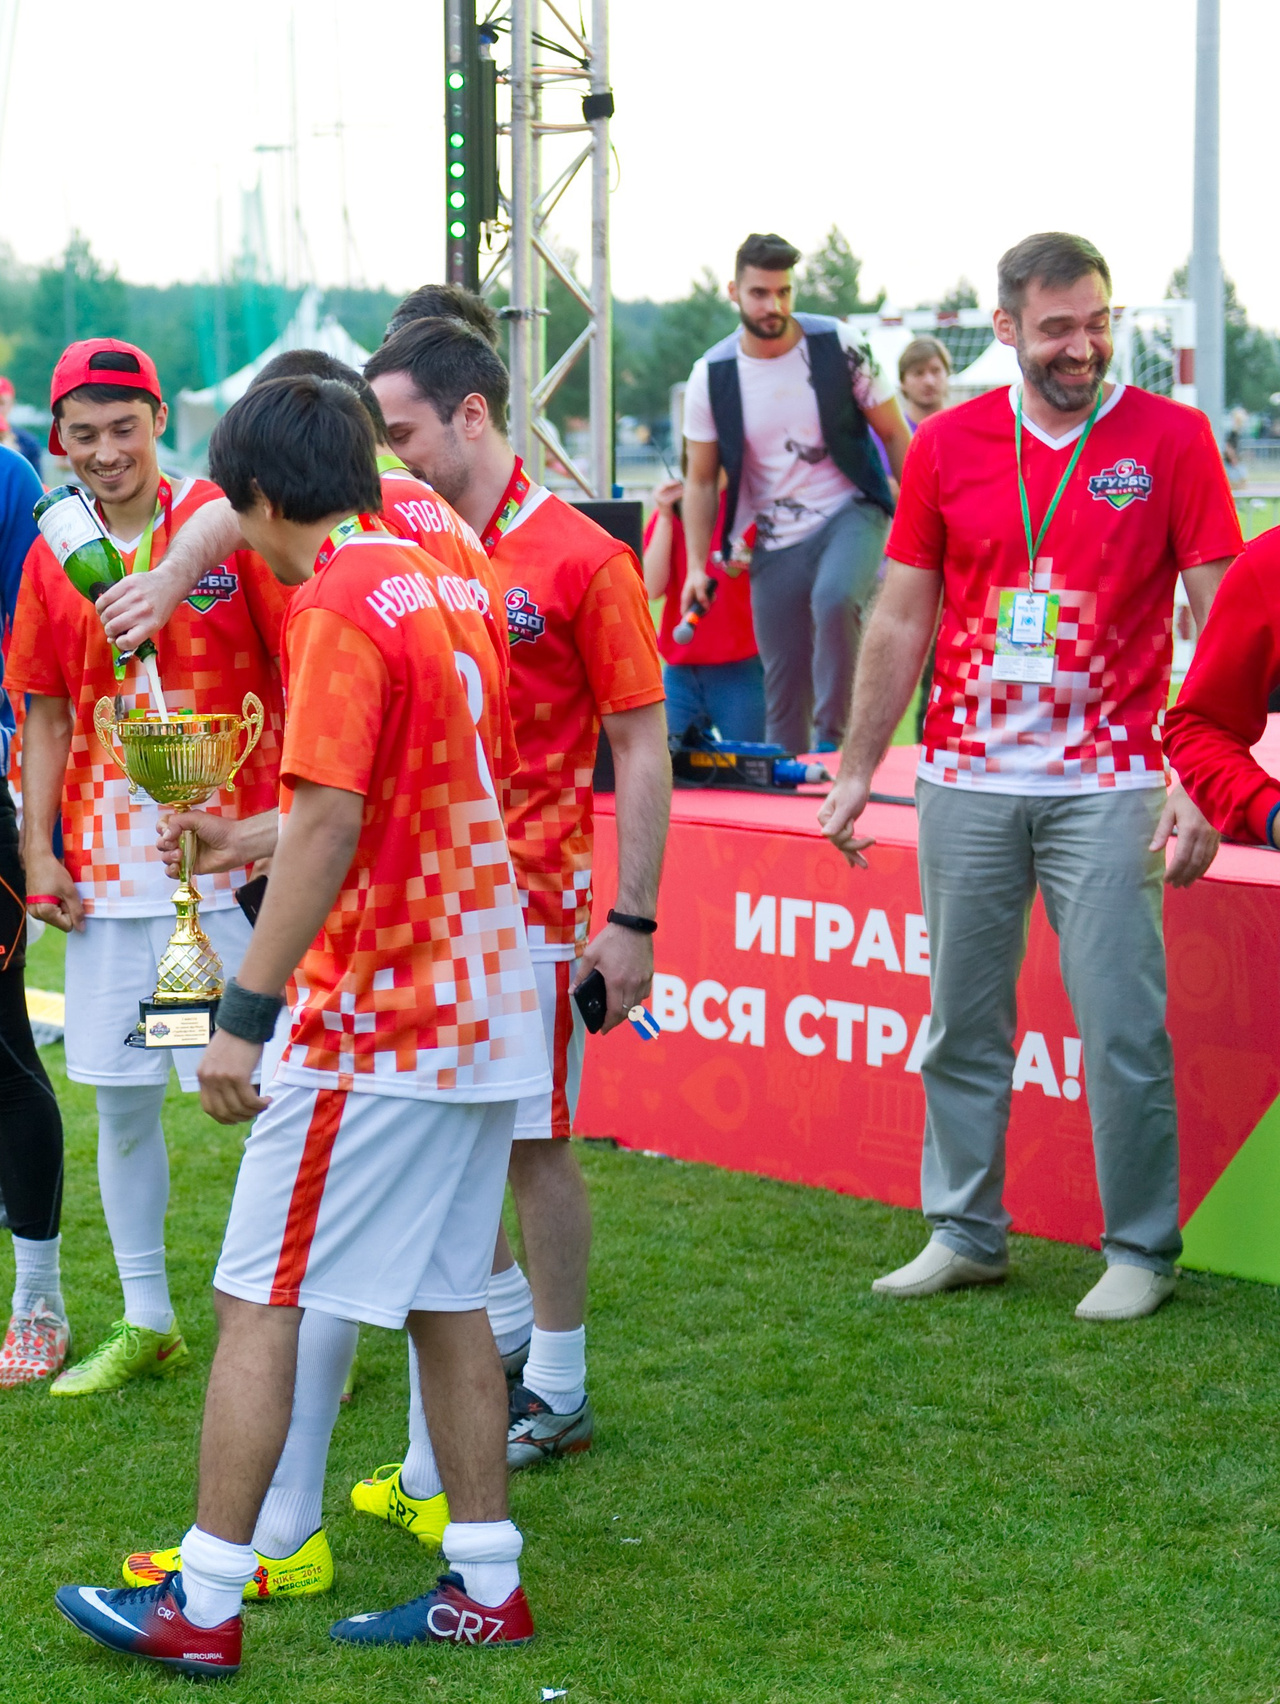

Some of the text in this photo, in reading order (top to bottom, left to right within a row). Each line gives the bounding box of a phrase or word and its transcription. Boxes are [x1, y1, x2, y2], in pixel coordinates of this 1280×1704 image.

[1094, 475, 1150, 488] ТУРБО
[507, 610, 541, 630] РБО
[735, 891, 932, 977] ИГРАЕ
[652, 972, 1082, 1101] ВСЯ СТРА!
[272, 1574, 296, 1586] NIKE
[157, 1606, 176, 1620] CR7
[427, 1603, 505, 1645] CR7
[182, 1652, 225, 1660] MERCURIAL
